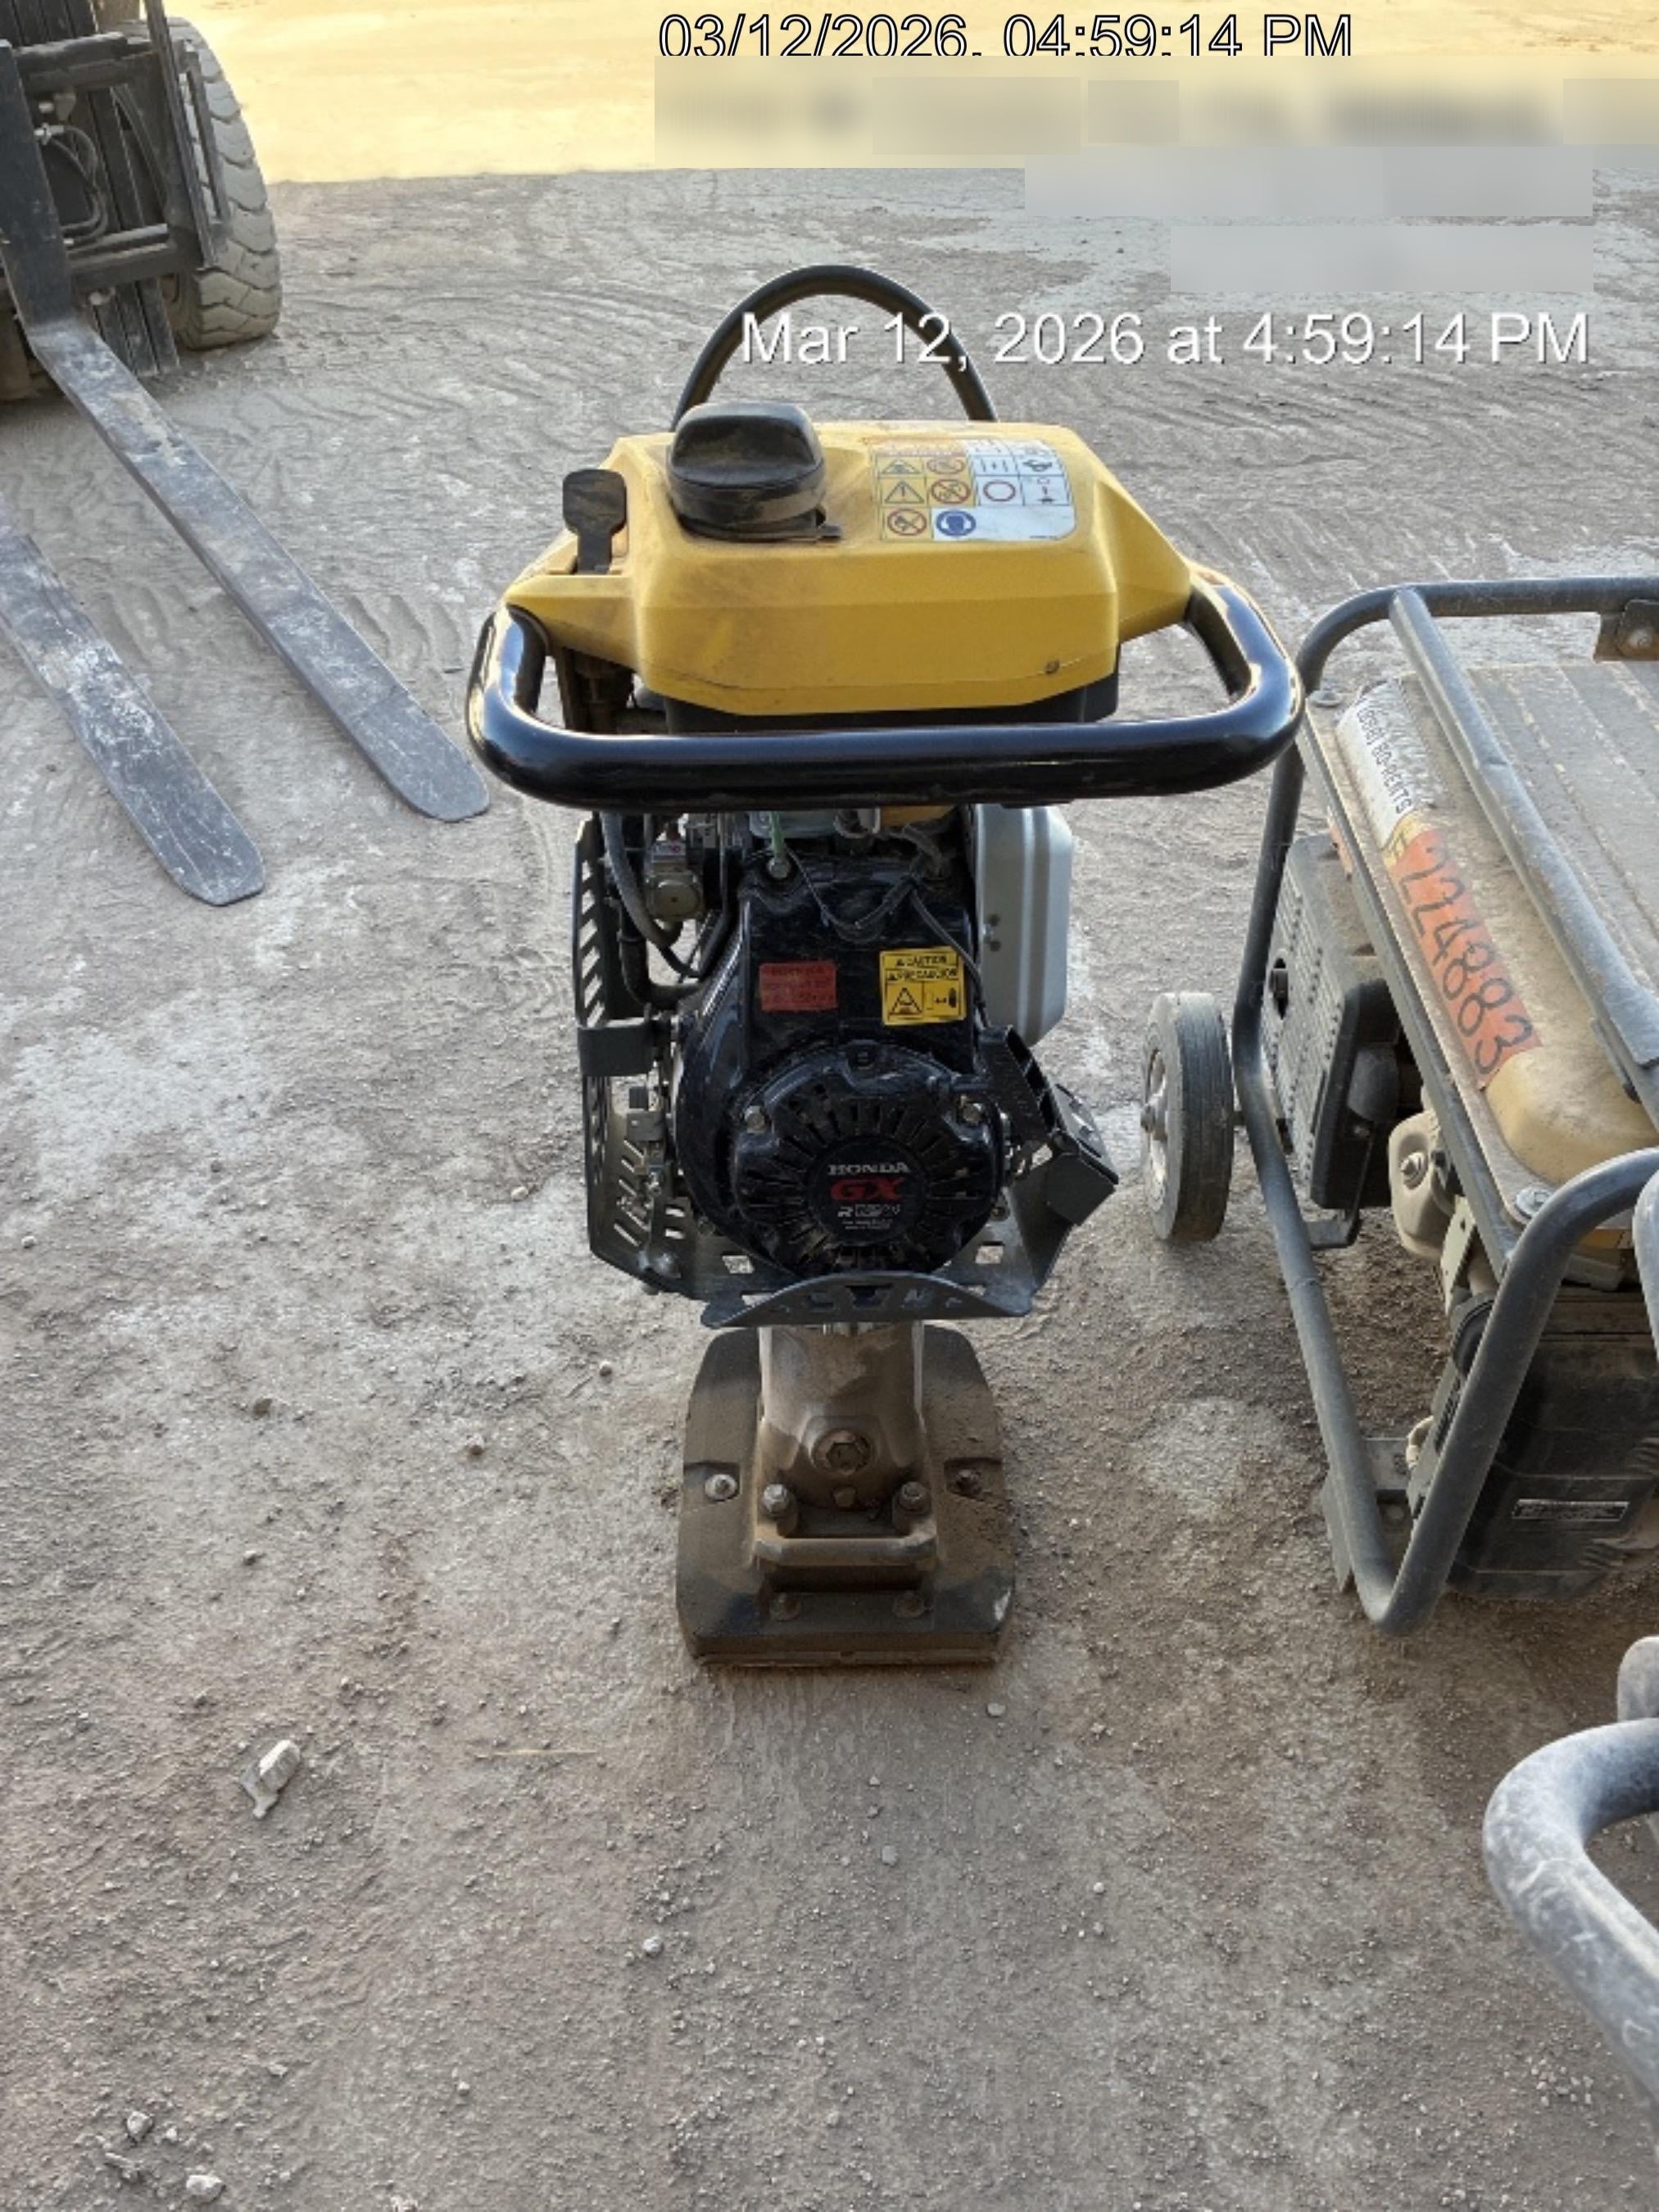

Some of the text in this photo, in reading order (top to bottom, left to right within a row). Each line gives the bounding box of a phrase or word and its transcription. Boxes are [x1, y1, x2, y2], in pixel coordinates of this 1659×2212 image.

[1398, 837, 1534, 1076] 224883
[827, 1162, 911, 1176] HONDA
[830, 1177, 905, 1202] GX
